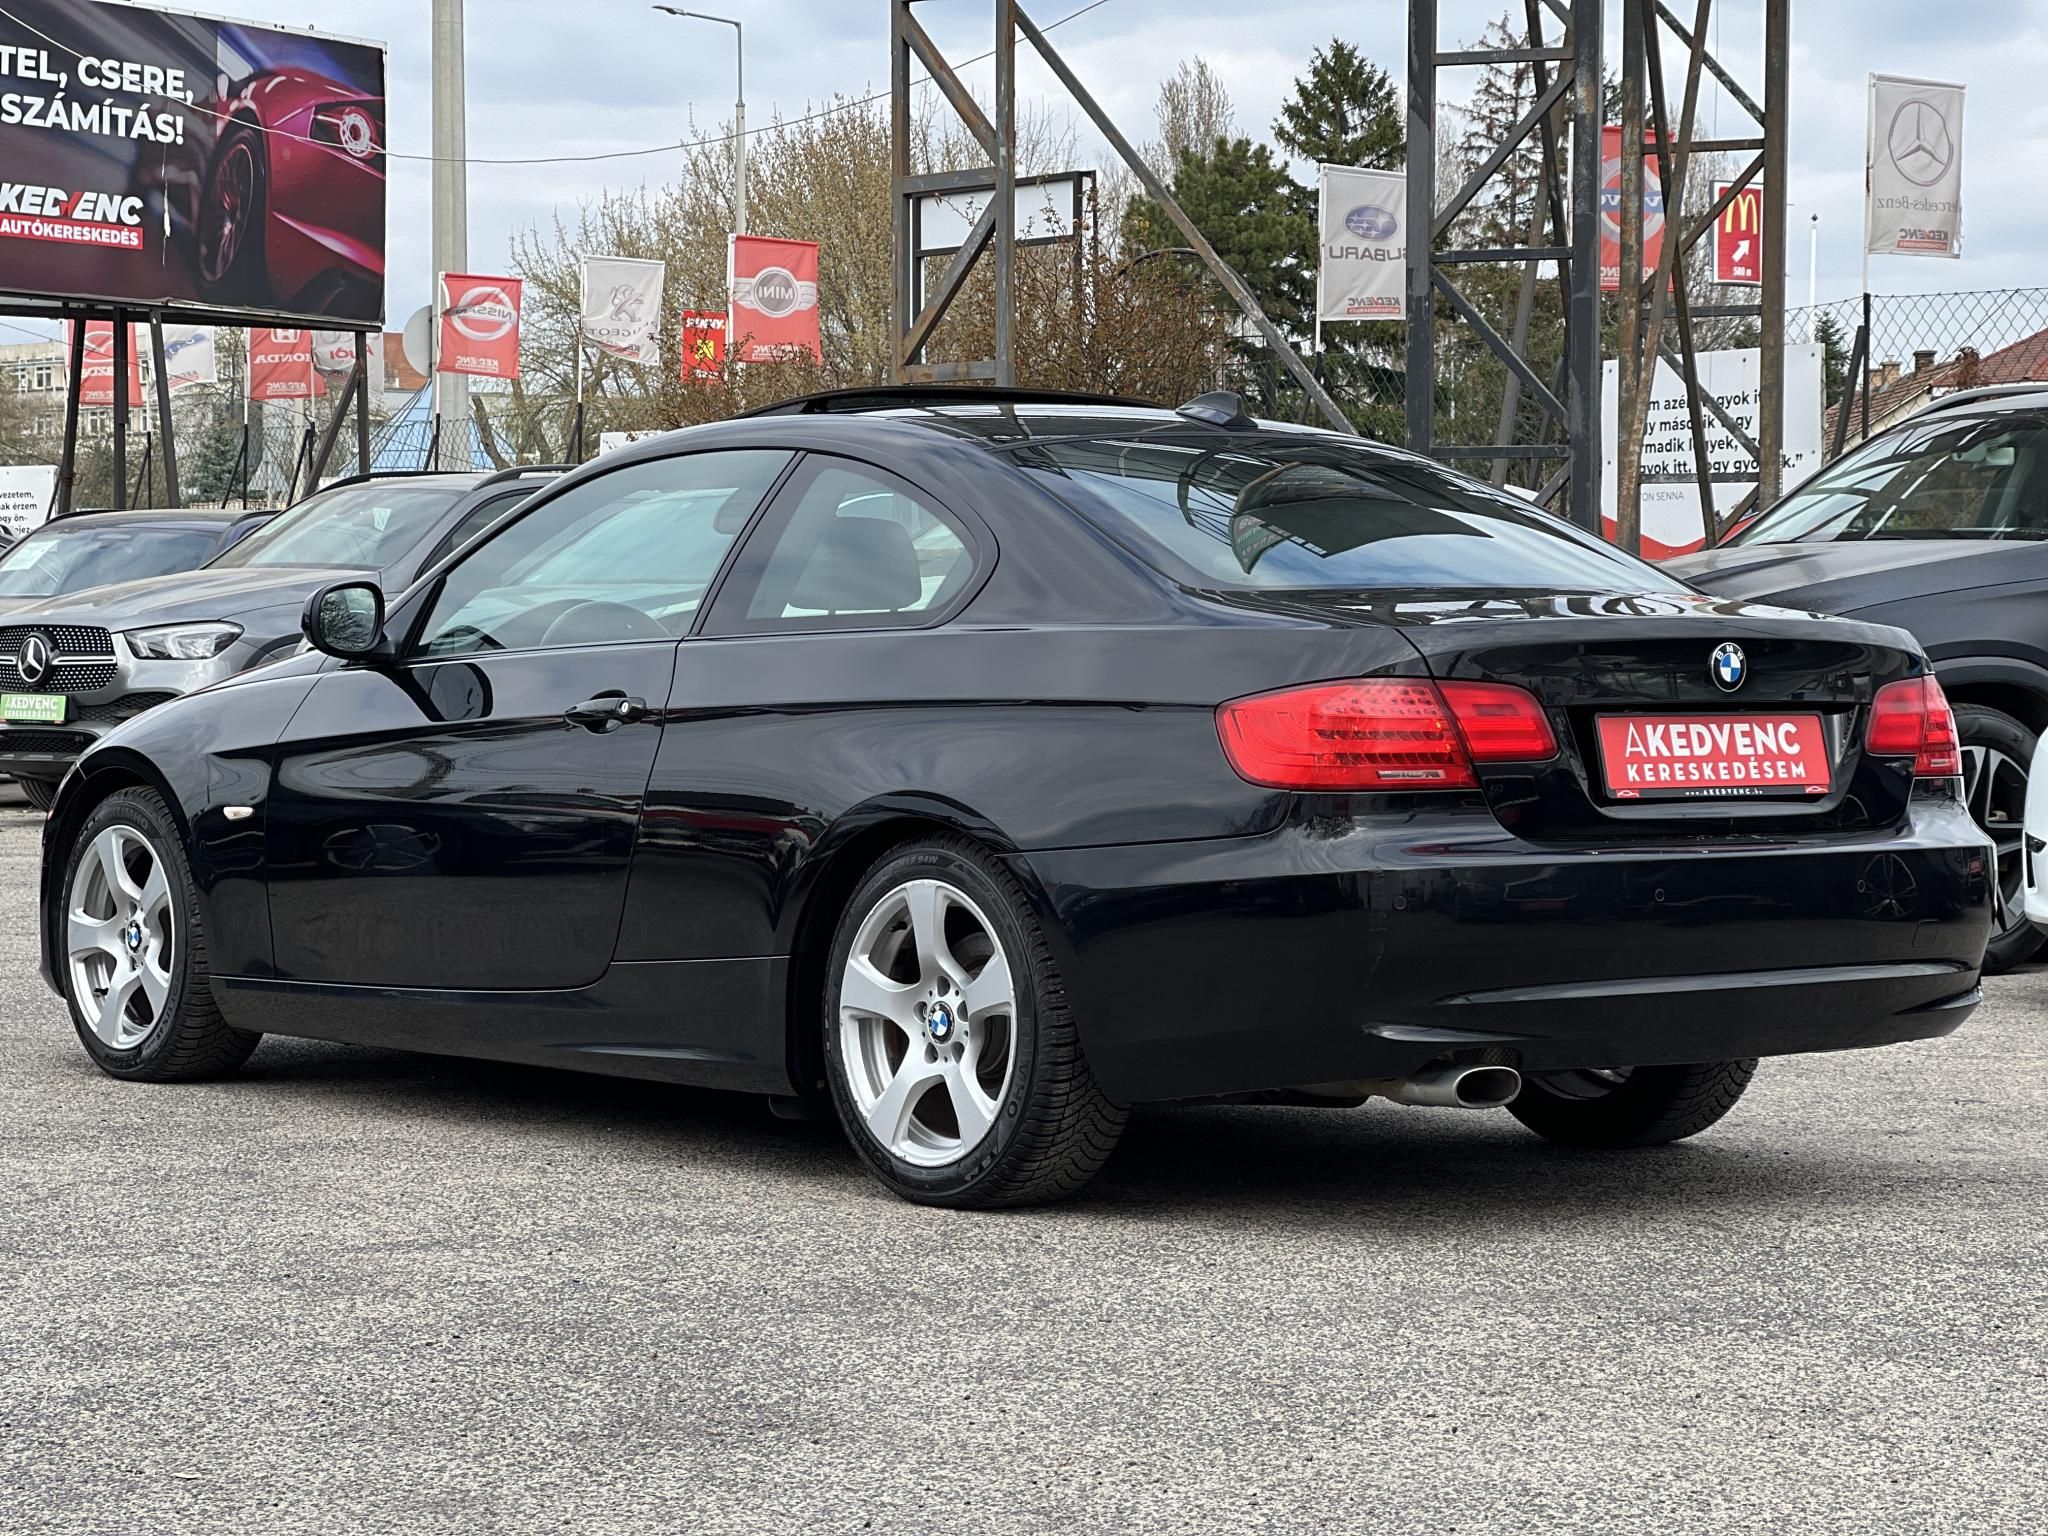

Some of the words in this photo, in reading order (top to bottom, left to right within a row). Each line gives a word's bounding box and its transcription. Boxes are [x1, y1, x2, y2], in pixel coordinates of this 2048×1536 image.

[77, 56, 194, 106] CSERE,
[0, 92, 184, 145] SZÁMÍTÁS!
[0, 182, 144, 226] KEDVENC
[0, 218, 139, 246] AUTÓKERESKEDÉS
[1656, 491, 1684, 501] SENNA
[1716, 644, 1744, 661] BMW
[1627, 757, 1806, 782] KERESKEDÉSEM
